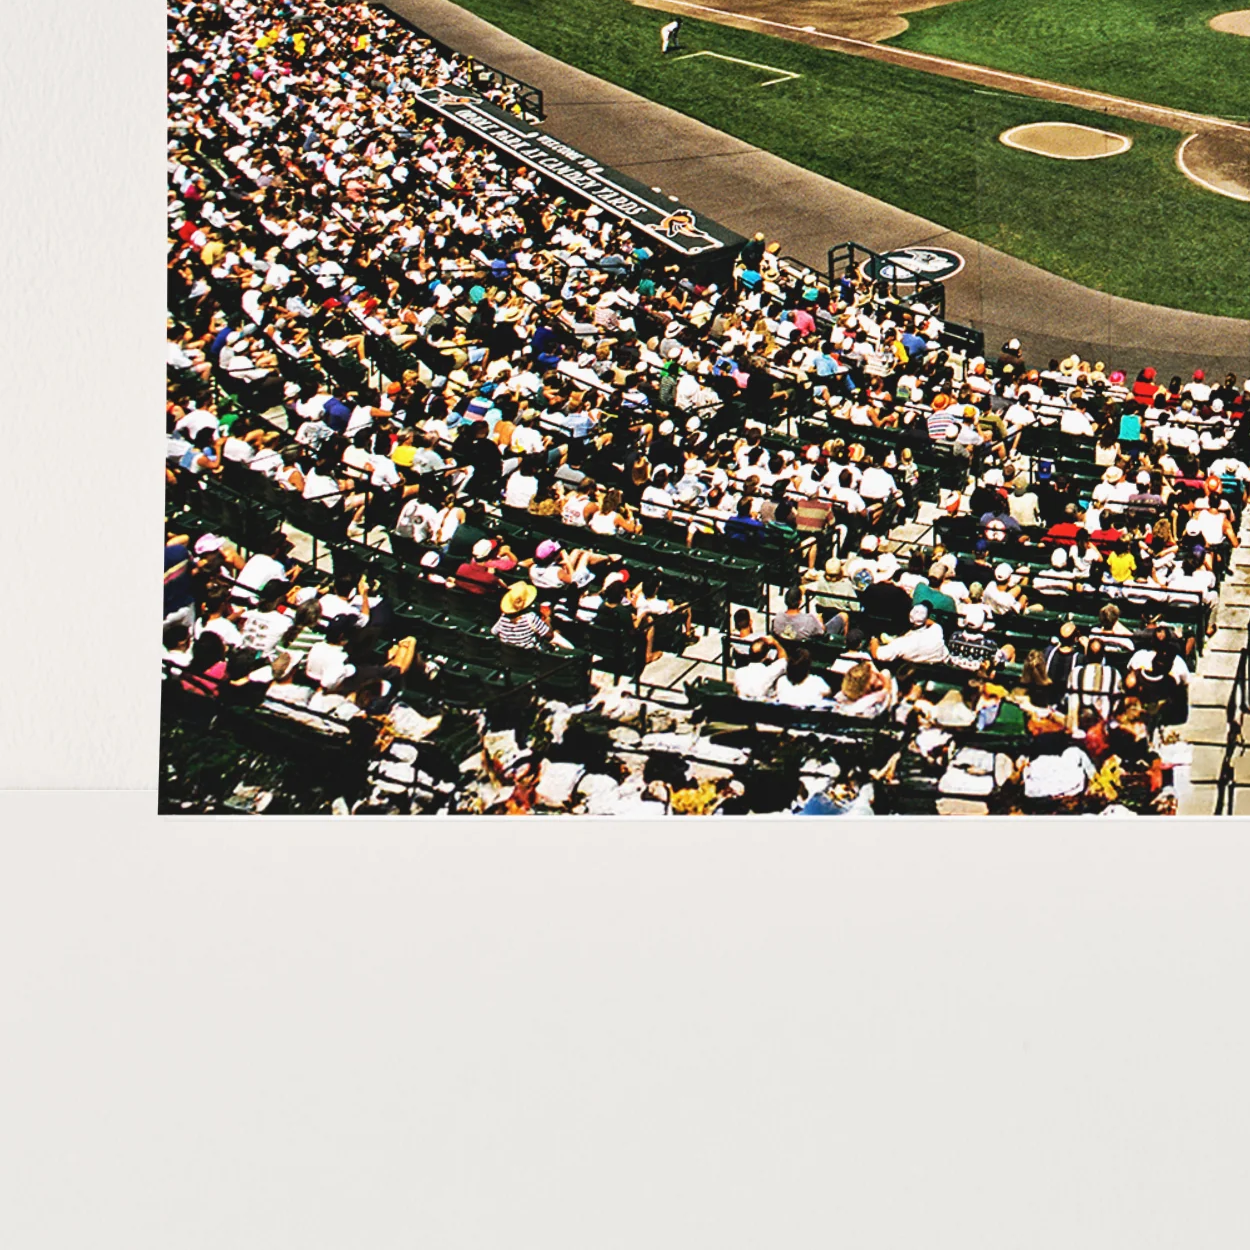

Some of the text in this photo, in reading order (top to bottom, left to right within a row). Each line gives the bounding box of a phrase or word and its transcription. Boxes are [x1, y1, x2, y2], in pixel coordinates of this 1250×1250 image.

[495, 129, 531, 150] PARK
[538, 156, 602, 190] CAMDEN
[592, 185, 648, 216] YARDS
[537, 135, 584, 162] WELCOME
